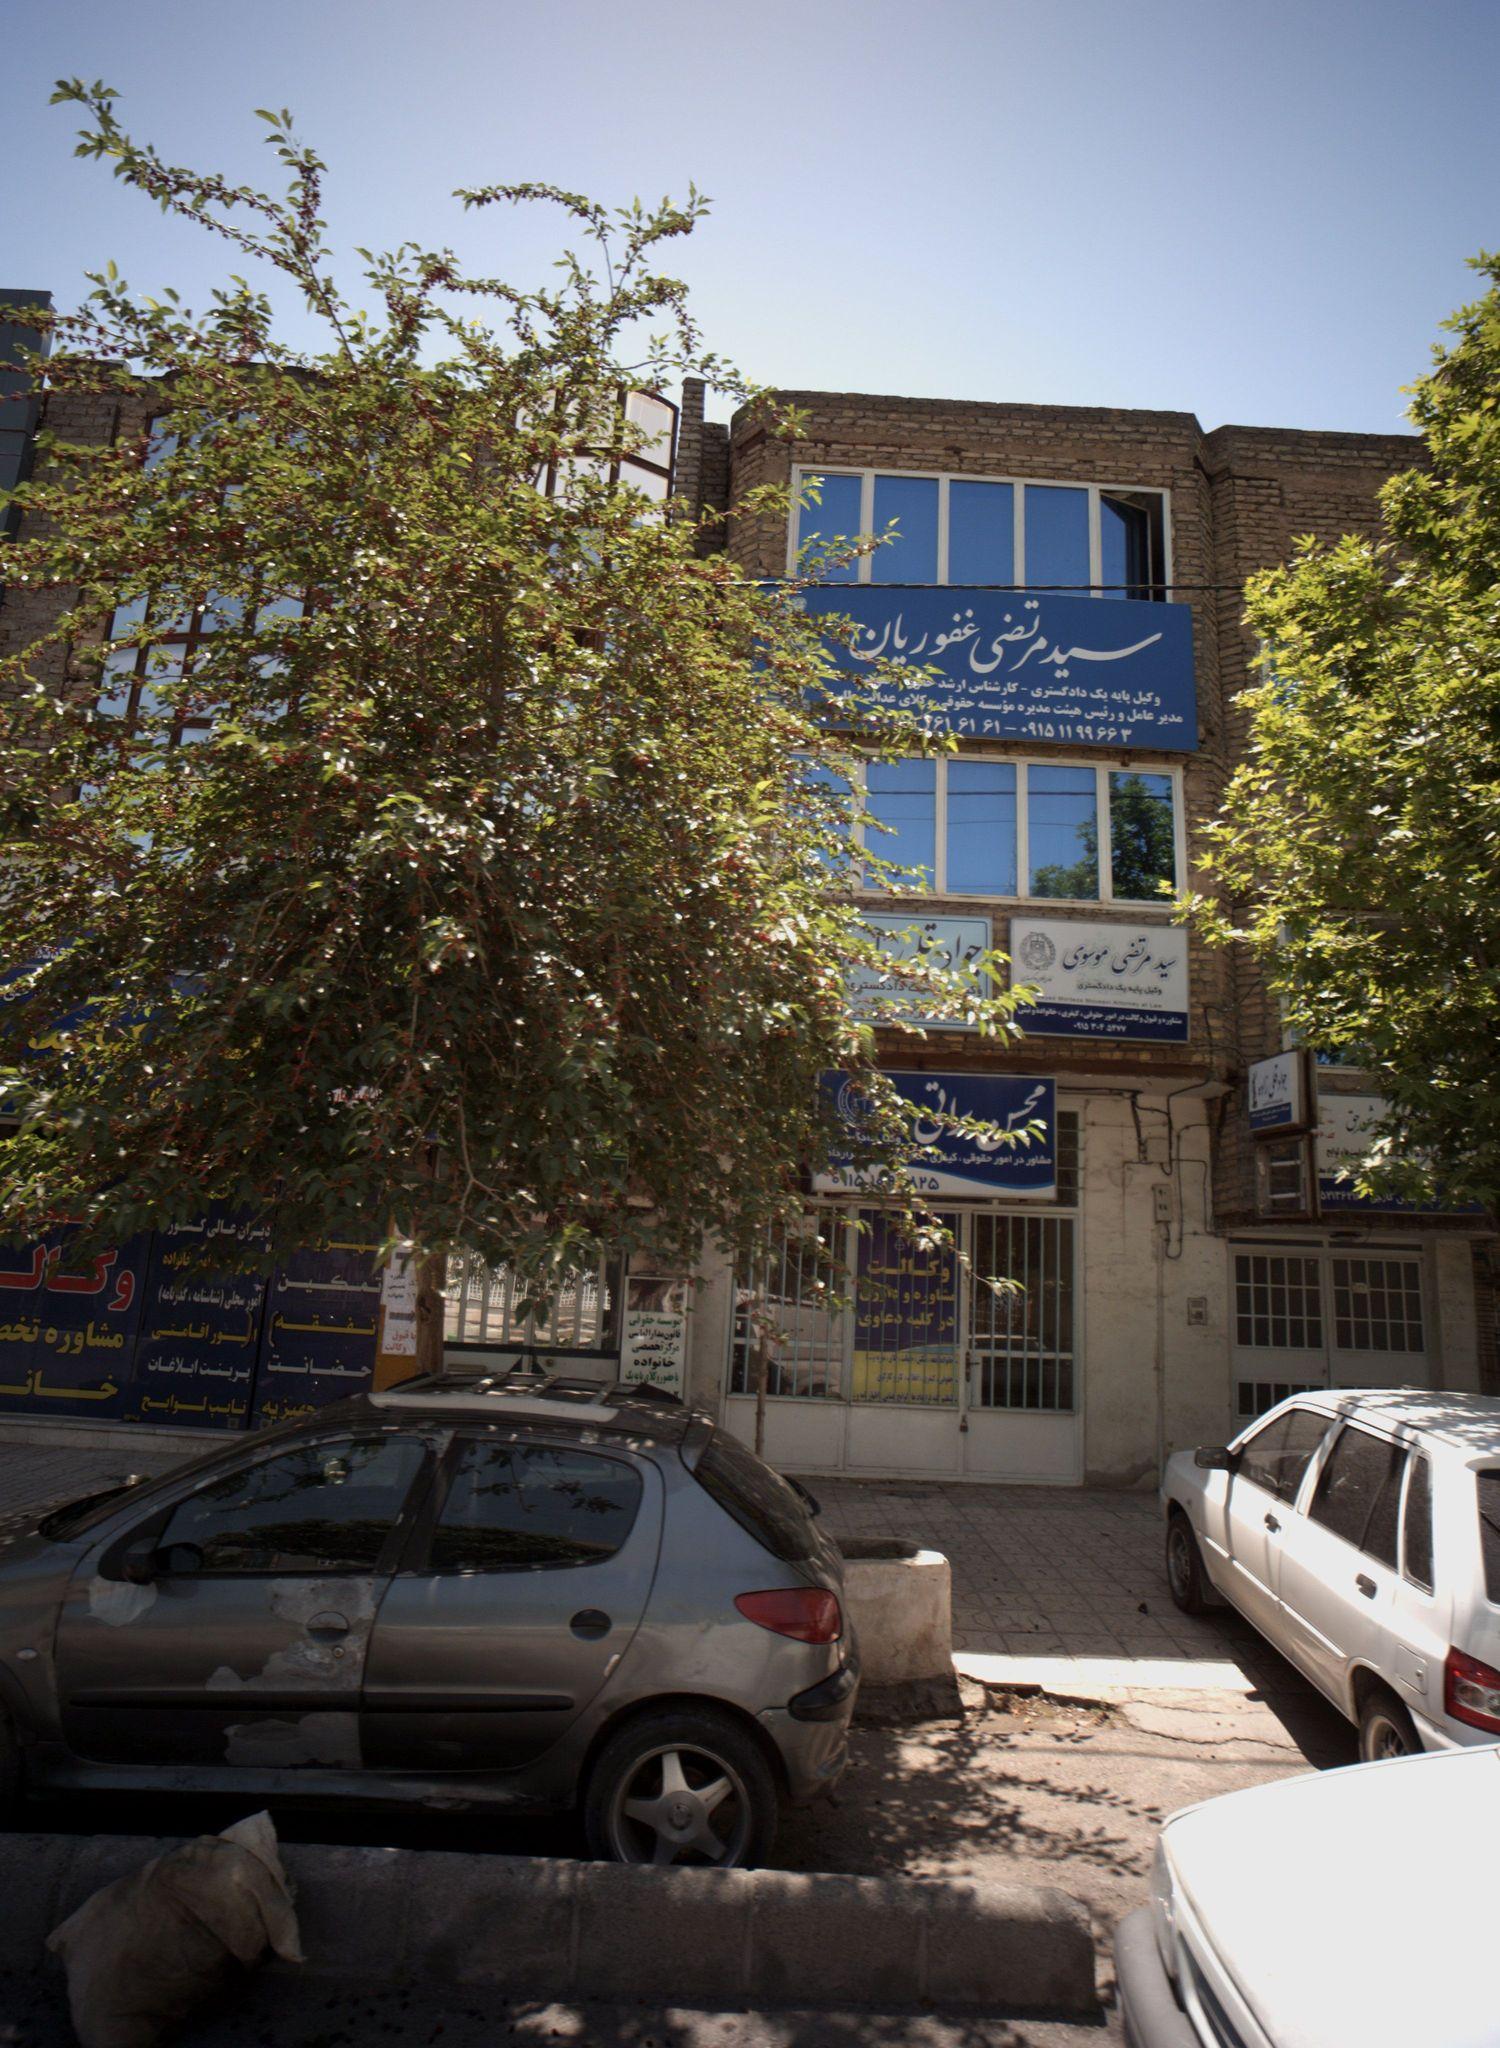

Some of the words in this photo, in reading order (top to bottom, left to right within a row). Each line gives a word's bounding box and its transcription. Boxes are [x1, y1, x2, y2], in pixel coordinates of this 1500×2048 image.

[849, 609, 980, 668] غفوریان
[938, 678, 966, 693] ارشد
[970, 680, 1018, 696] کارشناس
[1031, 684, 1087, 700] دادگستری
[1090, 687, 1108, 702] یک
[1110, 689, 1131, 705] پایه
[1133, 691, 1161, 707] وکیل
[1016, 700, 1051, 718] مدیره
[1085, 704, 1116, 721] رئیس
[1126, 707, 1155, 723] عامل
[1157, 711, 1184, 727] مدیر
[1062, 943, 1108, 971] موسوی
[1112, 936, 1151, 975] مرتضی
[1153, 957, 1178, 979] سید
[1077, 979, 1114, 992] دادگستری
[1115, 982, 1127, 993] یک
[1129, 983, 1143, 994] پایه
[1144, 983, 1163, 996] وکیل
[993, 1155, 1012, 1166] امور
[206, 1217, 237, 1240] عالی
[0, 1243, 135, 1312] وکال
[866, 1257, 951, 1284] وکالت
[277, 1273, 382, 1294] تمکین
[275, 1313, 376, 1337] نفقه
[858, 1311, 904, 1329] دعاوی
[907, 1311, 935, 1328] کلیه
[937, 1315, 956, 1332] در
[44, 1320, 125, 1355] مشاوره
[151, 1321, 210, 1340] اقامتی
[147, 1356, 199, 1378] ابلاغات
[267, 1353, 372, 1378] حضانت
[633, 1355, 676, 1370] خانواده
[200, 1361, 252, 1384] پرینت
